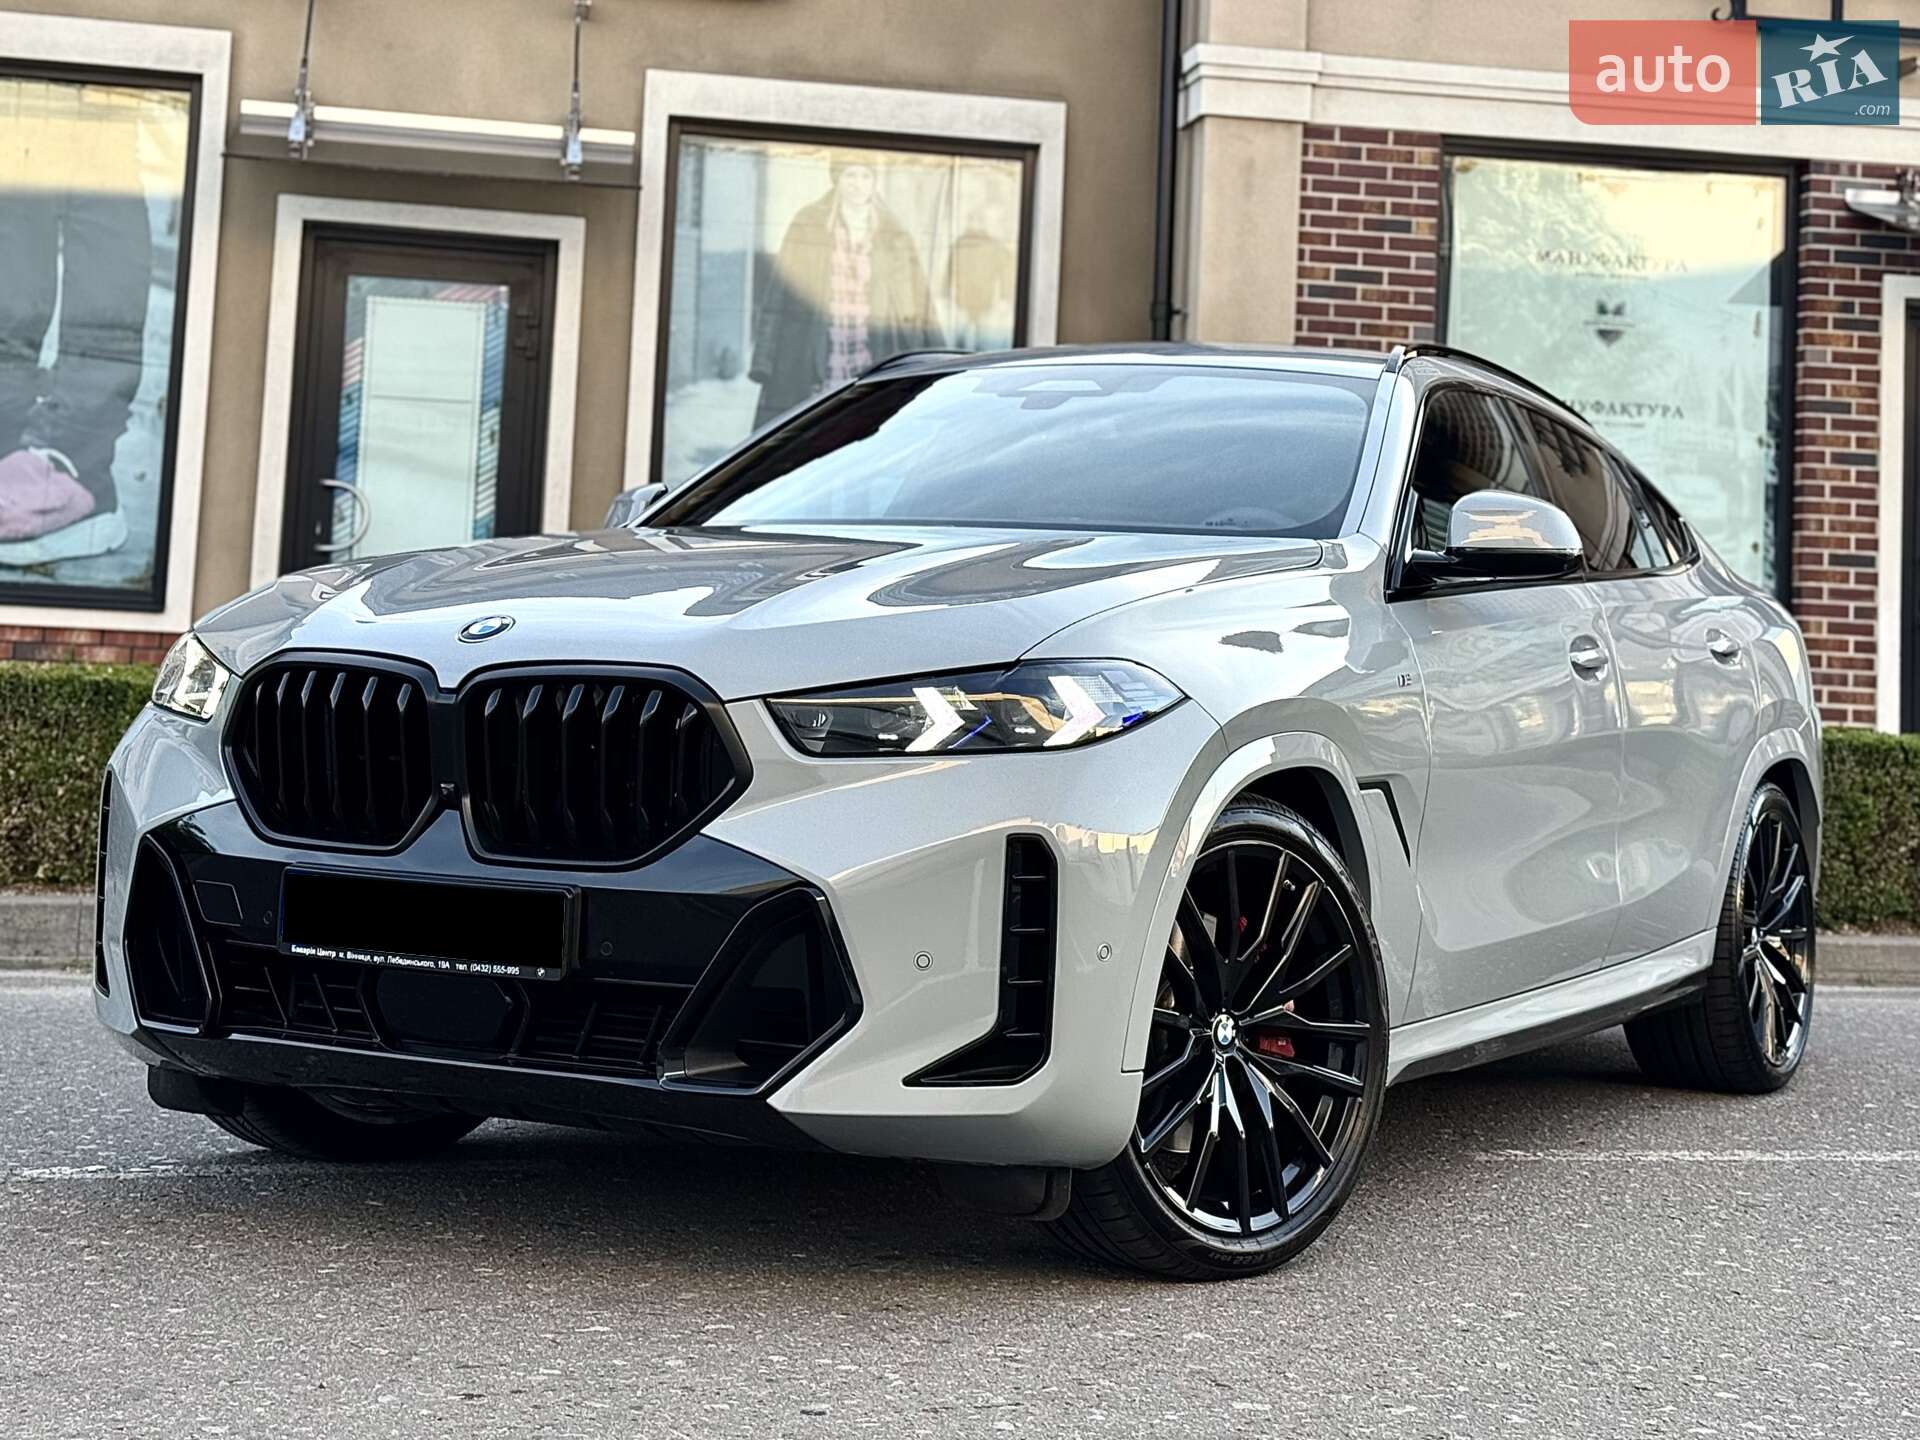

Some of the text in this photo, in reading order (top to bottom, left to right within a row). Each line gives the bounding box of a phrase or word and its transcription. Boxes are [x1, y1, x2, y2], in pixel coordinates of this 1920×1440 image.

[317, 948, 336, 959] Центр
[470, 963, 492, 975] (0432)
[493, 965, 520, 975] 555-995
